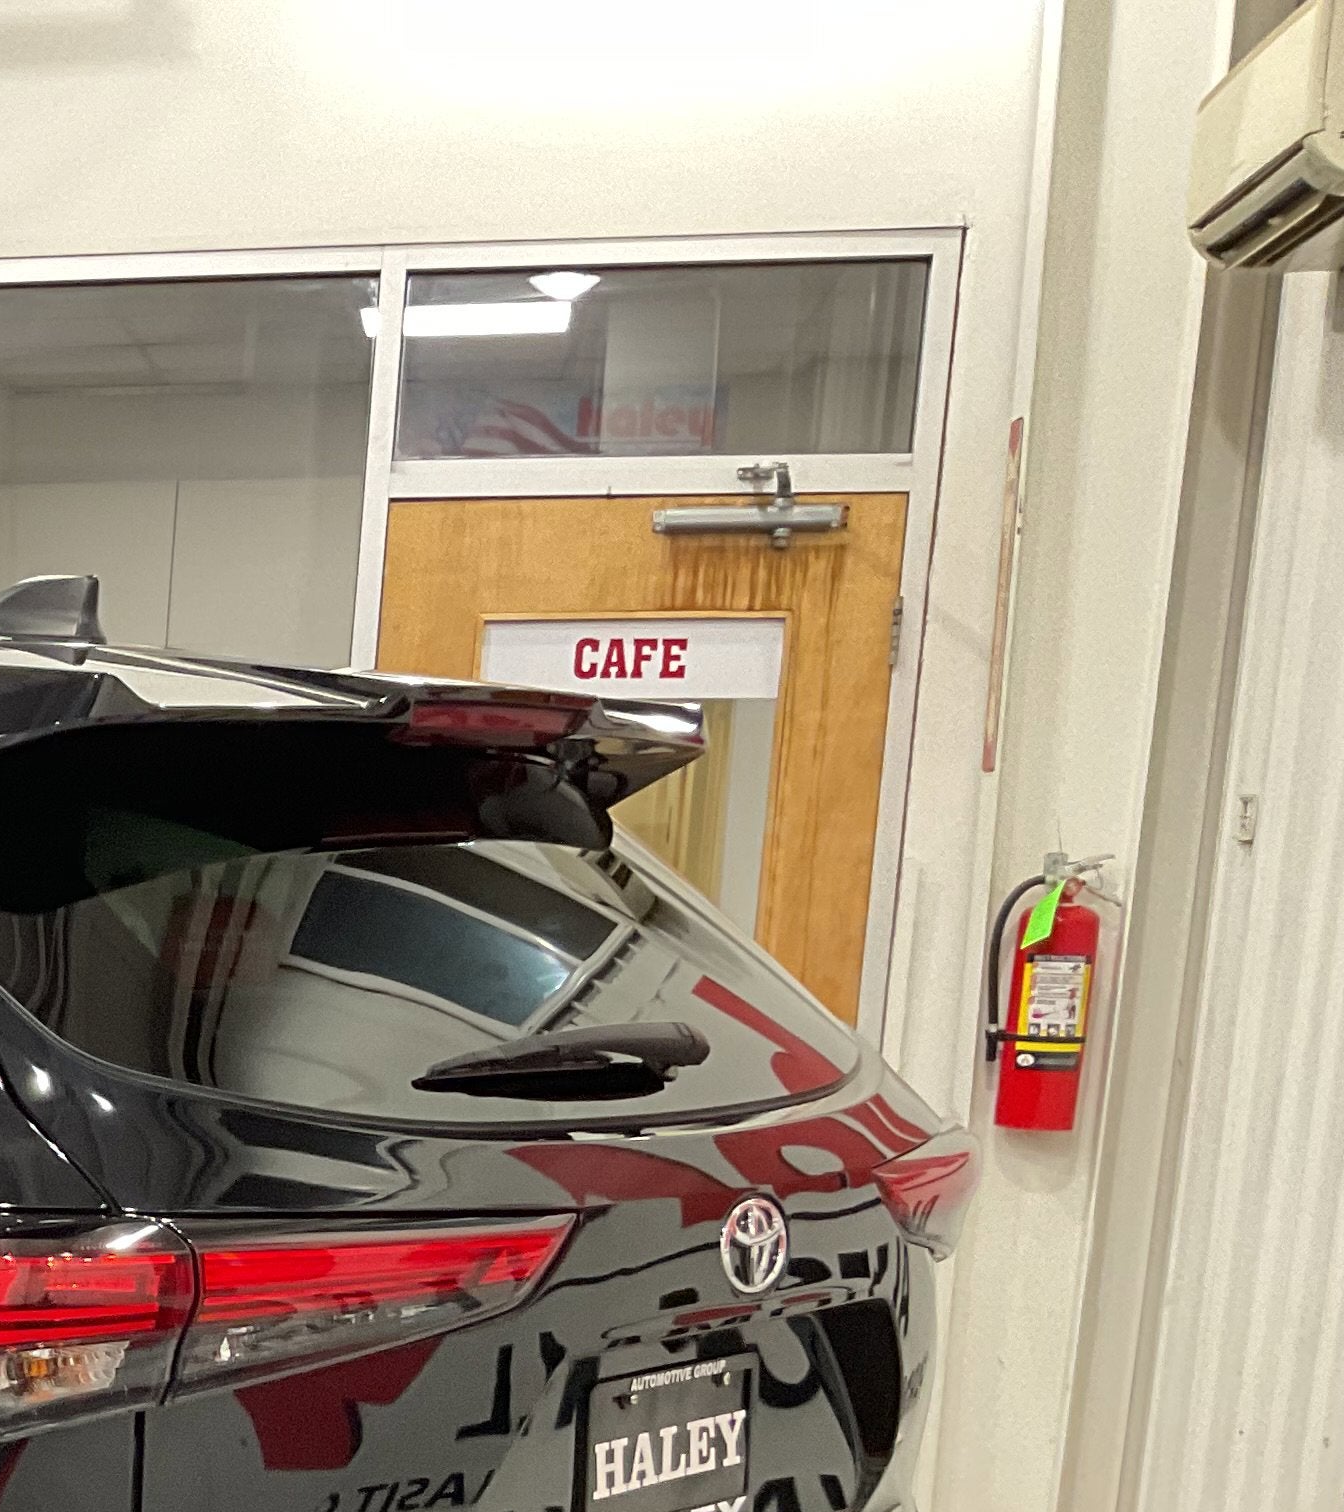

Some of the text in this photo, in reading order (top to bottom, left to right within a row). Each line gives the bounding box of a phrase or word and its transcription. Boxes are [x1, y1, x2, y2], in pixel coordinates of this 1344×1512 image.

[573, 637, 689, 680] CAFE
[630, 1359, 726, 1391] AUTOMOTIVE GROUP
[593, 1409, 747, 1500] HALEY
